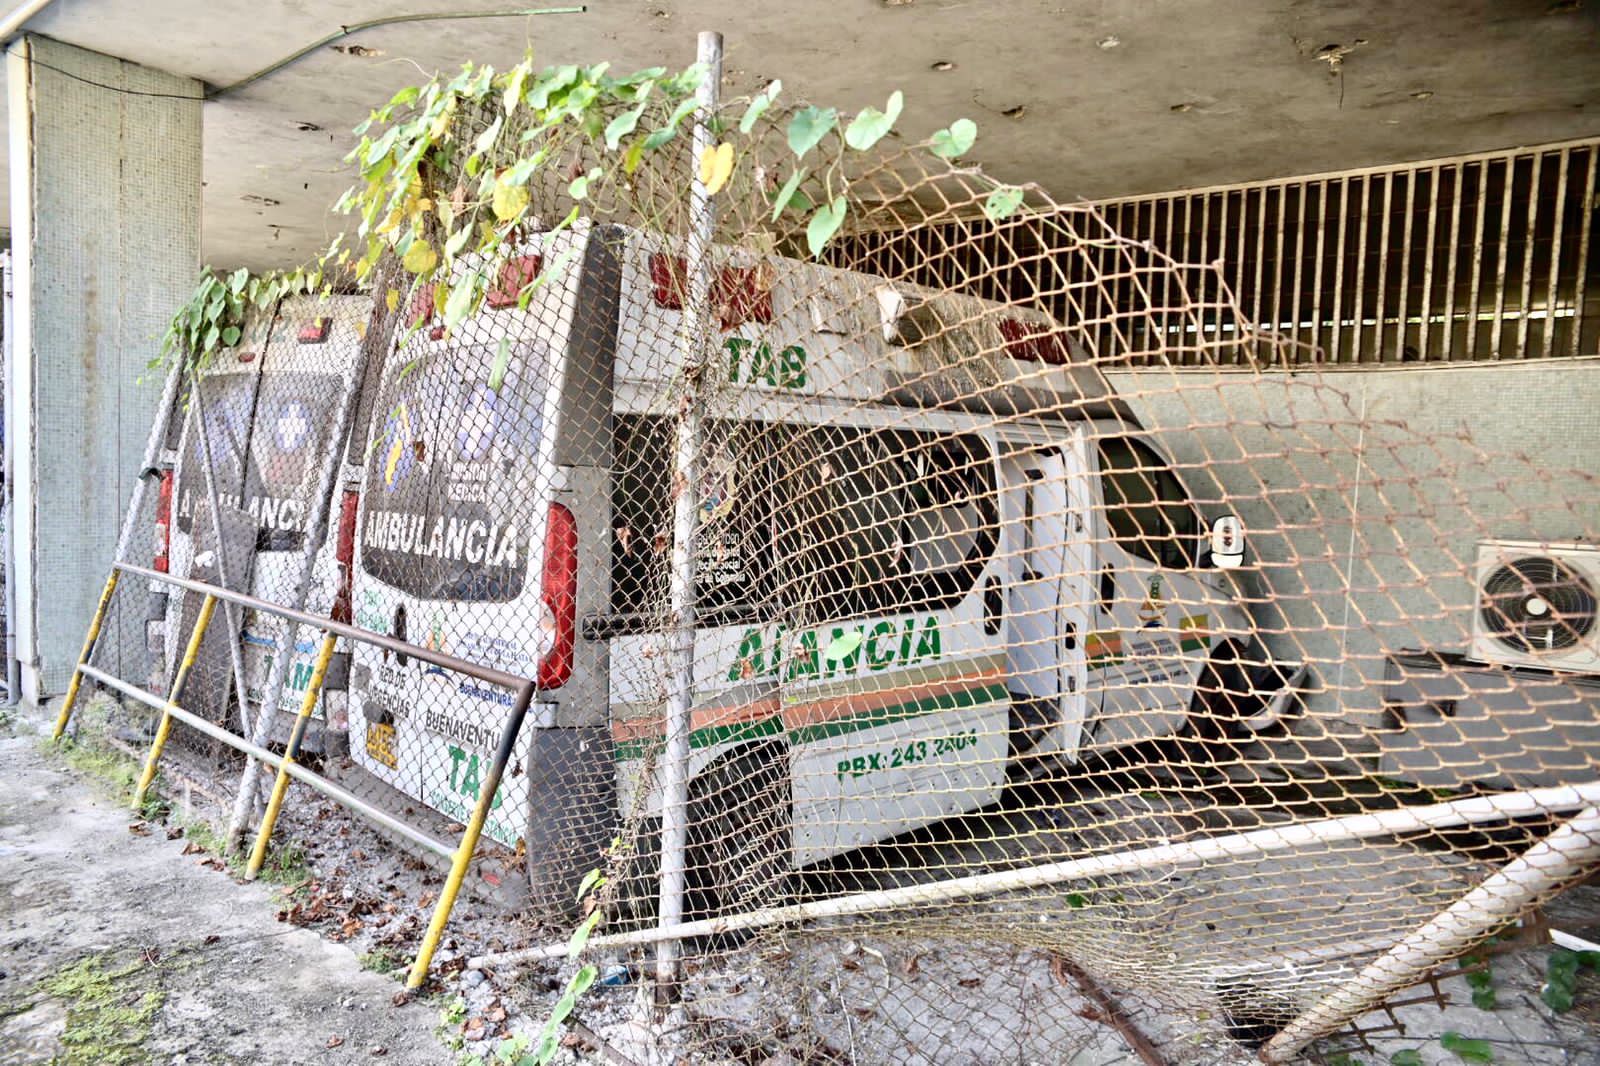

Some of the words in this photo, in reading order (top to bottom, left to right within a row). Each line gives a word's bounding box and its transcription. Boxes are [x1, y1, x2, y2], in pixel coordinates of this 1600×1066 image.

[364, 510, 519, 569] AMBULANCIA
[426, 709, 501, 751] BUENAVENTU
[890, 741, 927, 769] 243
